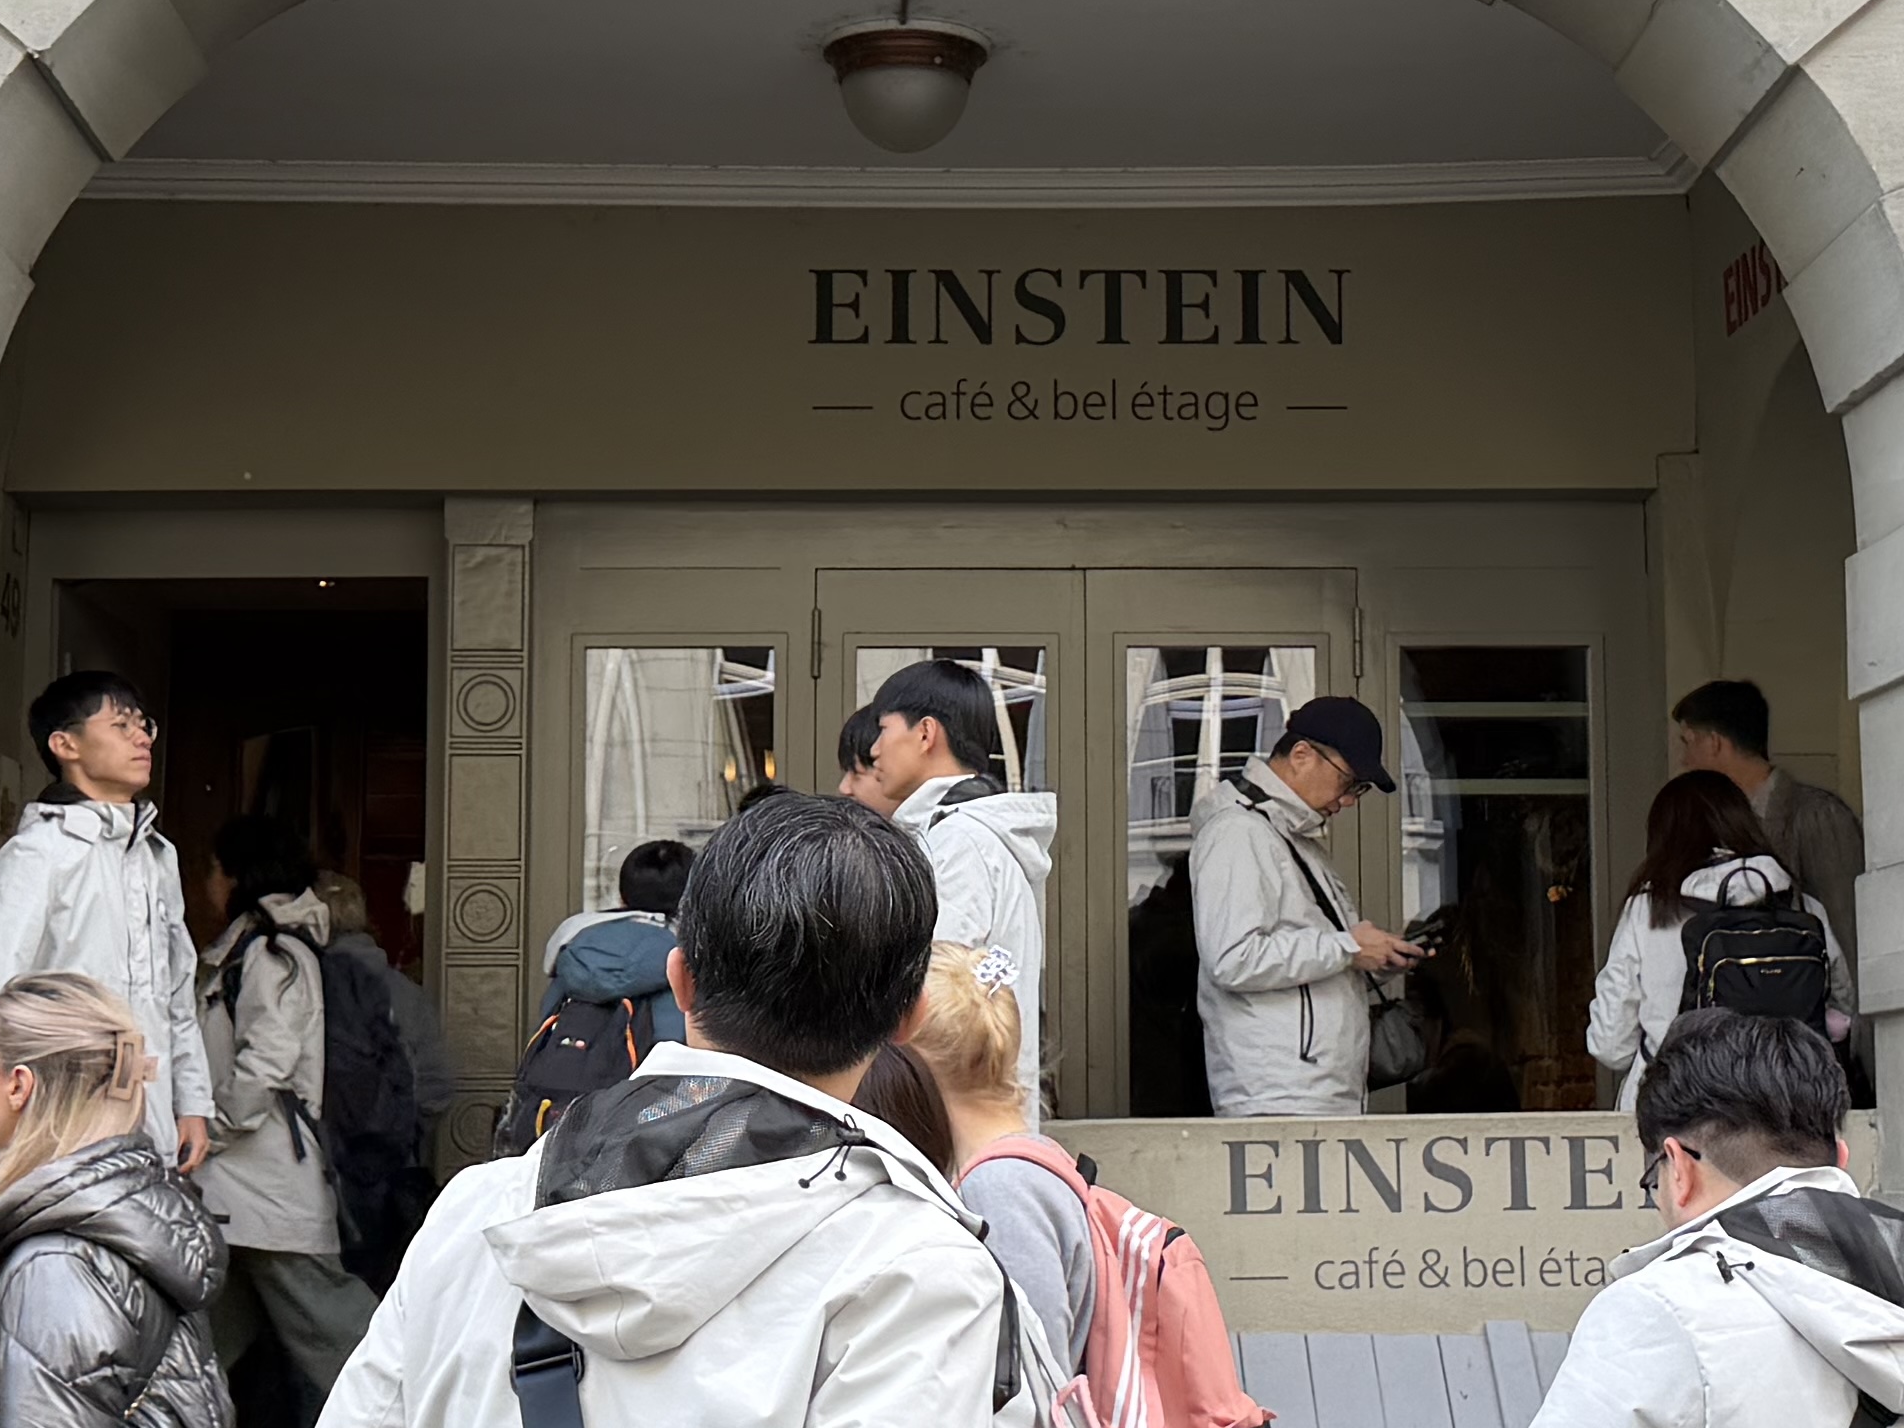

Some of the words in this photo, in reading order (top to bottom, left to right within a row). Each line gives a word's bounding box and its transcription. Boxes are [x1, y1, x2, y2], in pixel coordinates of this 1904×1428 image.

[807, 267, 1351, 347] EINSTEIN
[899, 379, 994, 422] café
[1006, 382, 1042, 422] &
[1053, 378, 1116, 422] bel
[1130, 379, 1259, 432] étage
[1313, 1246, 1406, 1291] café
[1418, 1249, 1450, 1289] &
[1463, 1246, 1526, 1289] bel
